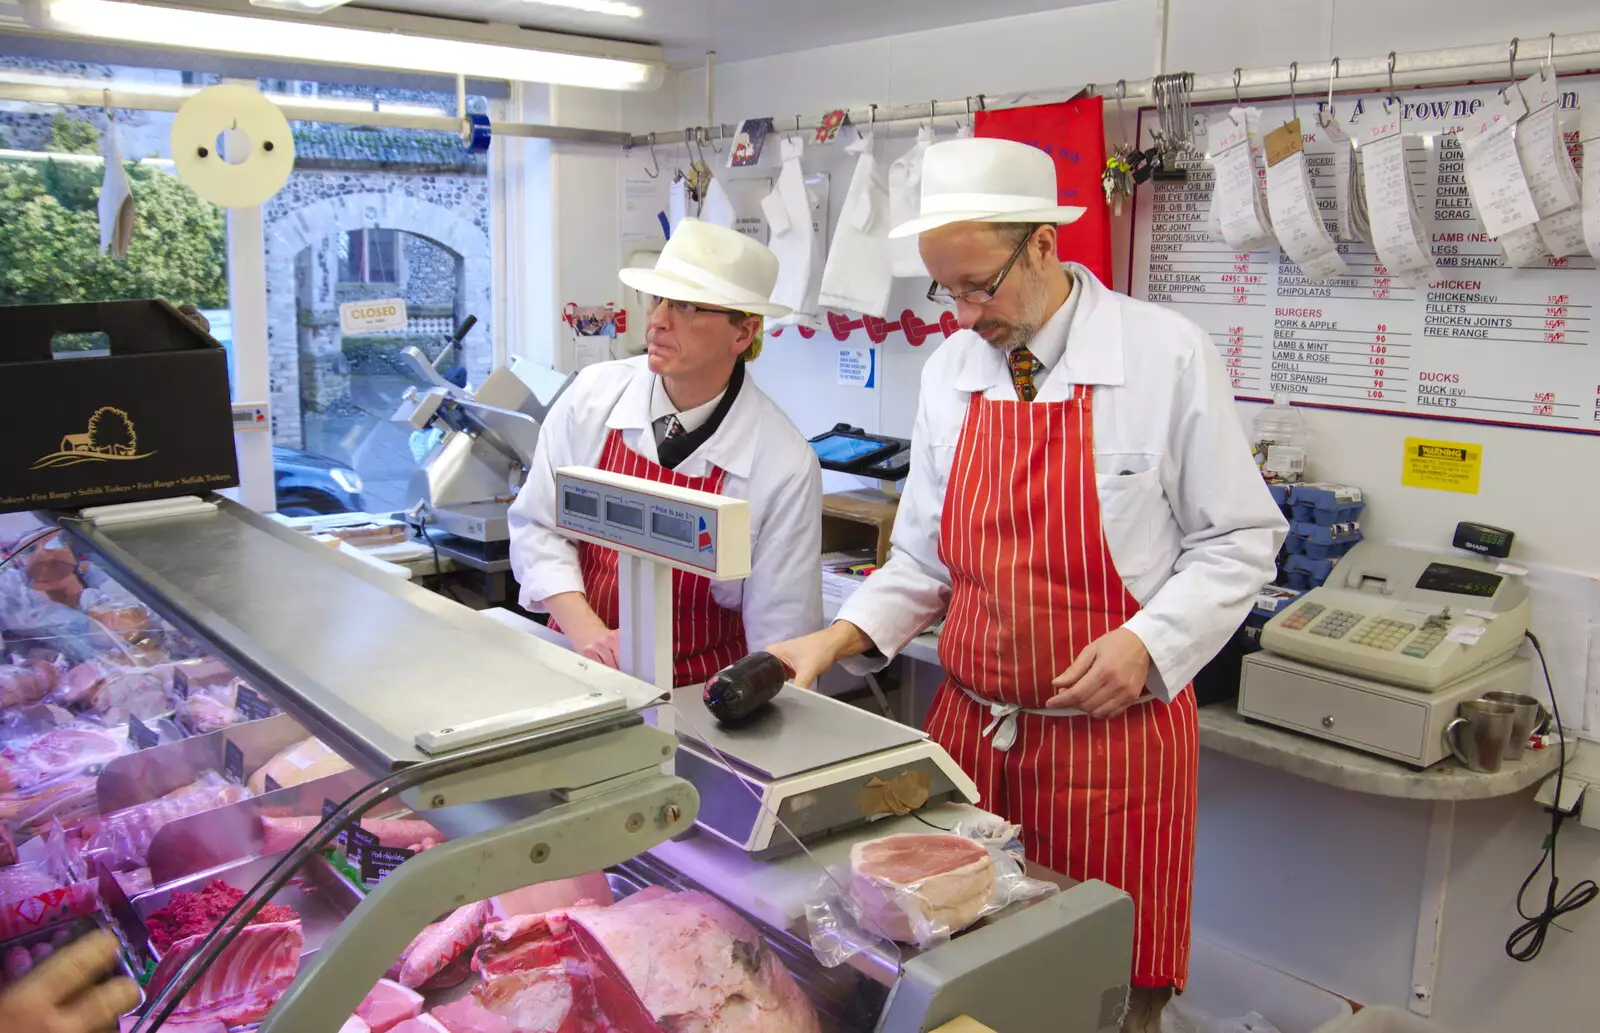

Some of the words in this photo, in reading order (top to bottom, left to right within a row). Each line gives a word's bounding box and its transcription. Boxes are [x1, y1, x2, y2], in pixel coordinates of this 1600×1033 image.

[1179, 152, 1205, 160] STEAK
[1184, 192, 1210, 200] STEAK
[1437, 187, 1469, 196] CHUM
[1435, 198, 1473, 208] FILLET
[1176, 213, 1202, 221] STEAK
[1434, 210, 1471, 219] SCRAG
[1168, 223, 1192, 231] JOINT
[1432, 233, 1464, 242] LAMB
[1150, 243, 1184, 252] BRISKET
[1431, 245, 1459, 255] LEGS
[1150, 254, 1168, 262] SHIN
[1436, 257, 1459, 266] AMB
[1461, 257, 1505, 267] SHANK
[1149, 263, 1173, 271] MINCE
[1149, 274, 1174, 282] FILLET
[1175, 274, 1201, 282] STEAK
[1148, 284, 1168, 292] BEEF
[1168, 284, 1206, 293] DRIPPING
[1276, 287, 1332, 296] CHIPOLATAS
[1148, 293, 1173, 301] OXTAIL
[350, 305, 397, 320] CLOSED
[1275, 307, 1323, 318] BURGERS
[1425, 303, 1467, 313] FILLETS
[1274, 319, 1299, 328] PORK
[1301, 320, 1307, 328] &
[1308, 320, 1339, 330] APPLE
[1425, 315, 1472, 326] CHICKEN
[1473, 318, 1514, 328] JOINTS
[1273, 330, 1297, 339] BEEF
[1424, 327, 1450, 337] FREE
[1451, 328, 1490, 339] RANGE
[1272, 340, 1297, 349] LAMB
[1298, 342, 1305, 350] &
[1306, 342, 1329, 351] MINT
[1272, 351, 1296, 360] LAMB
[1297, 352, 1304, 361] &
[1306, 352, 1331, 362] ROSE
[1271, 361, 1300, 371] CHILLI
[1270, 372, 1289, 381] HOT
[1290, 373, 1329, 384] SPANISH
[1418, 371, 1460, 384] DUCKS
[1269, 382, 1309, 393] VENISON
[1417, 384, 1447, 395] DUCK
[1416, 396, 1458, 408] FILLETS
[1421, 445, 1463, 458] WARNING
[1465, 541, 1489, 552] SHARP
